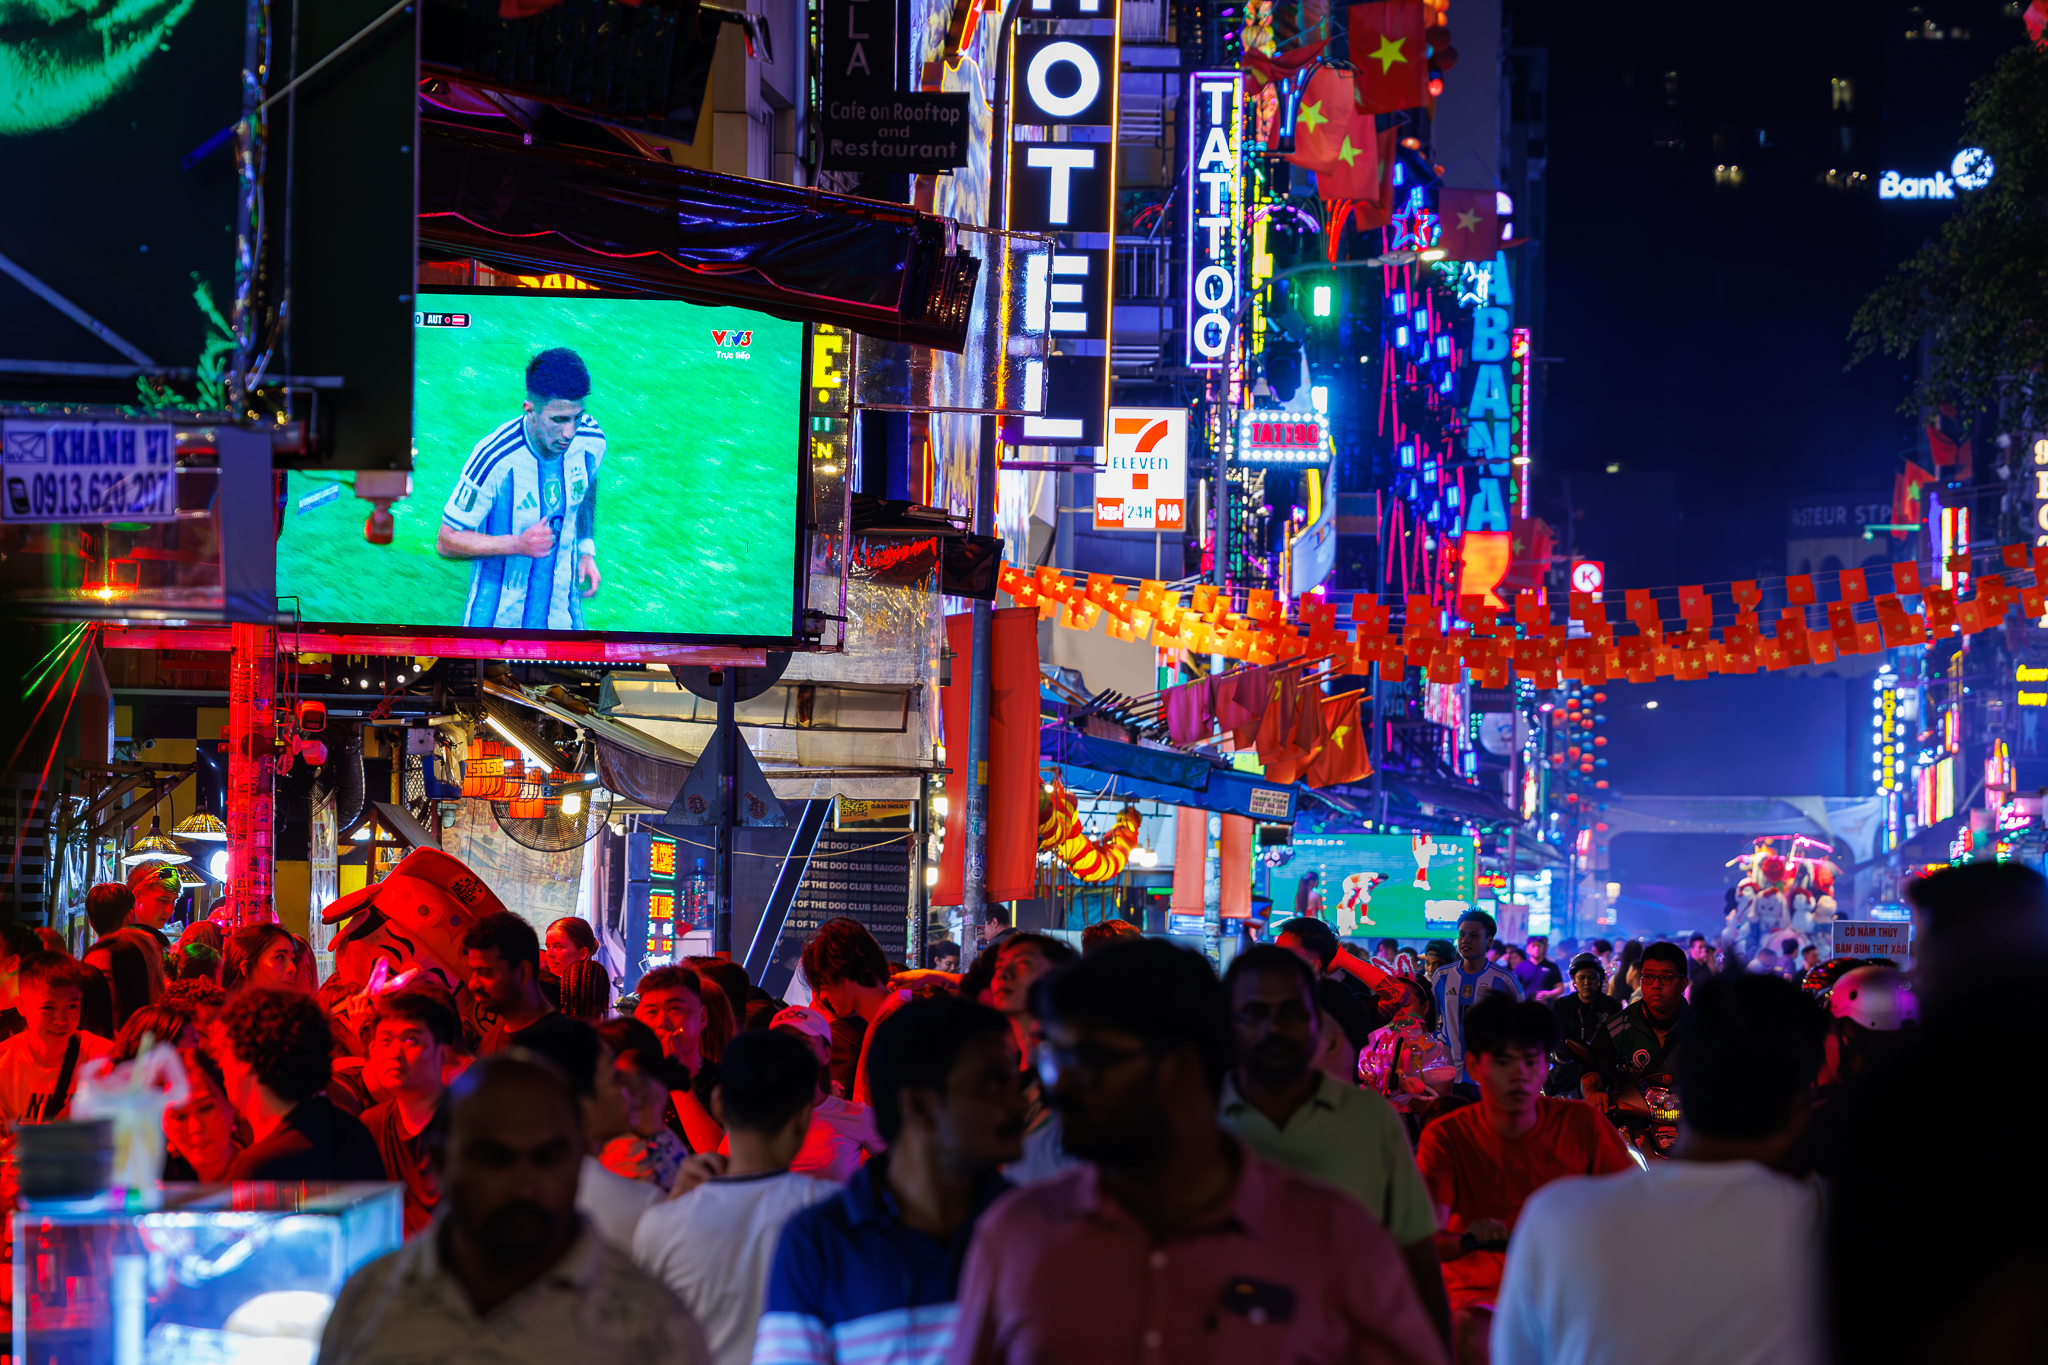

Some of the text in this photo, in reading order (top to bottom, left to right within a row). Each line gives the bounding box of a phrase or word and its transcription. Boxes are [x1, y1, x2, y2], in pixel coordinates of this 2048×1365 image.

[846, 0, 870, 76] LA
[830, 101, 960, 127] Cafe on Rooftop
[878, 125, 910, 138] and
[830, 138, 957, 158] Restaurant
[1880, 170, 1956, 199] Bank
[1023, 0, 1100, 438] OTEL
[1193, 82, 1234, 357] TATTOO
[427, 314, 443, 325] AUT
[716, 350, 750, 361] Trực tiếp
[1251, 422, 1319, 444] TATTOO
[145, 430, 168, 464] VI
[1127, 505, 1153, 519] 24H
[830, 842, 849, 850] DOG
[874, 844, 908, 854] SAIGON
[811, 861, 908, 873] THE DOG CLUB SAIGON
[811, 881, 828, 889] THE
[829, 882, 848, 890] DOG
[849, 882, 872, 891] CLUB
[872, 884, 907, 893] SAIGON
[798, 900, 906, 913] OF THE DOG CLUB SAIGON
[796, 920, 809, 928] OF
[871, 923, 905, 933] SAIGON
[1854, 942, 1870, 953] BÚN
